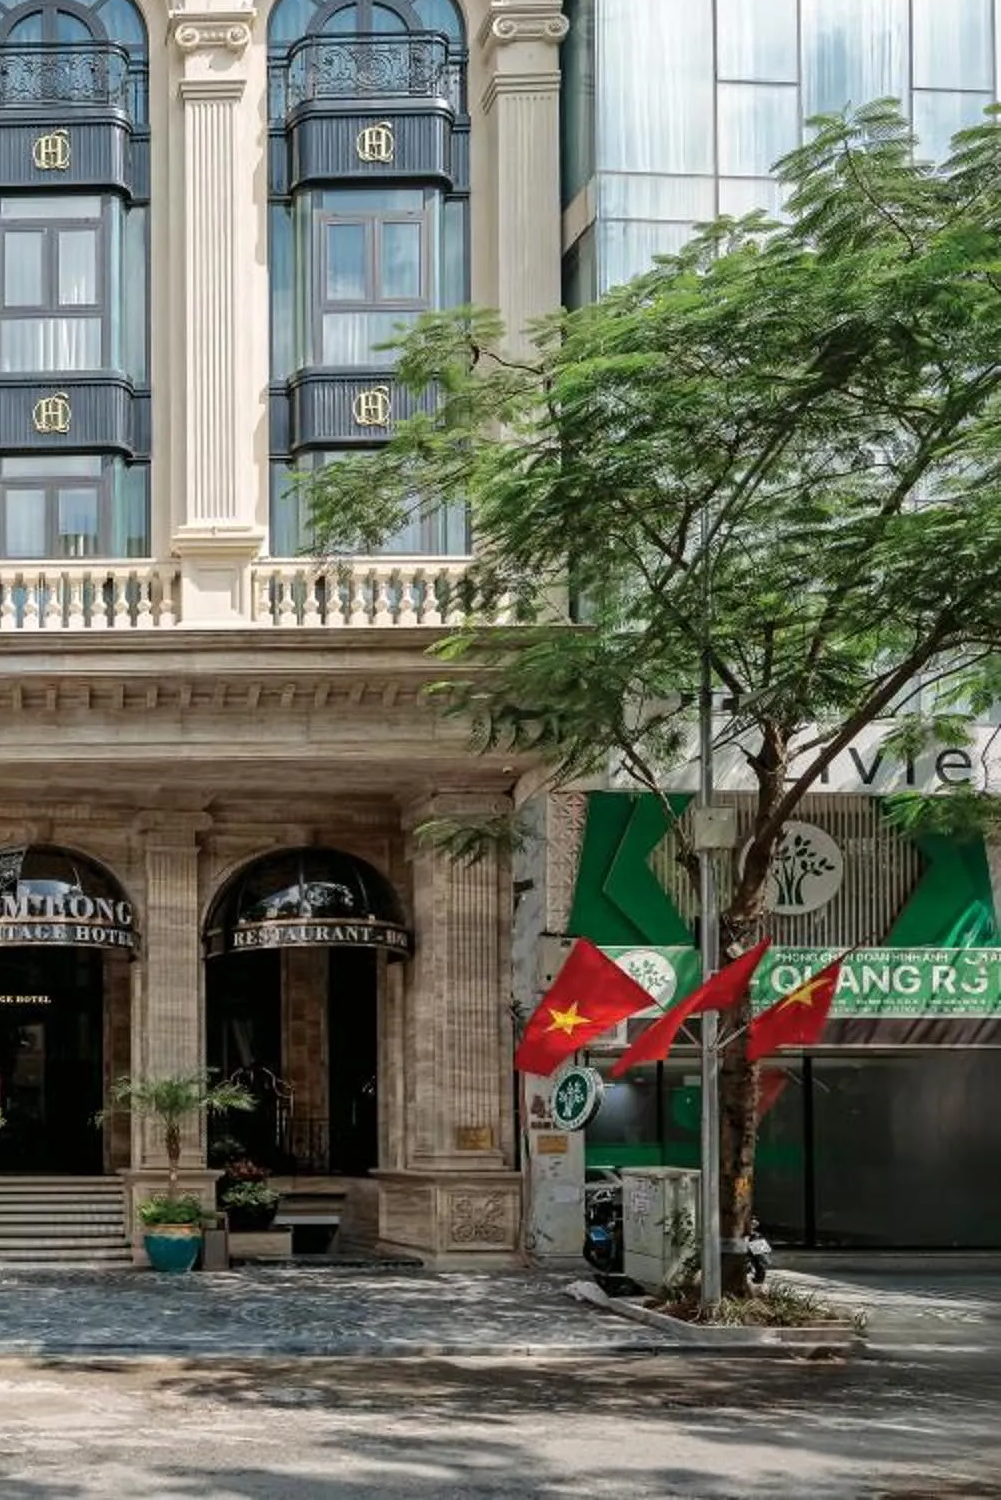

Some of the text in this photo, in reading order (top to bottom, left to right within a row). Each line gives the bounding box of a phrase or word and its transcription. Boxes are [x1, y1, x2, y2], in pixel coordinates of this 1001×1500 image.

[75, 925, 135, 947] HOTEL
[233, 924, 372, 947] RESTAURANT
[771, 964, 922, 995] QANG
[16, 994, 52, 1004] HOTEL
